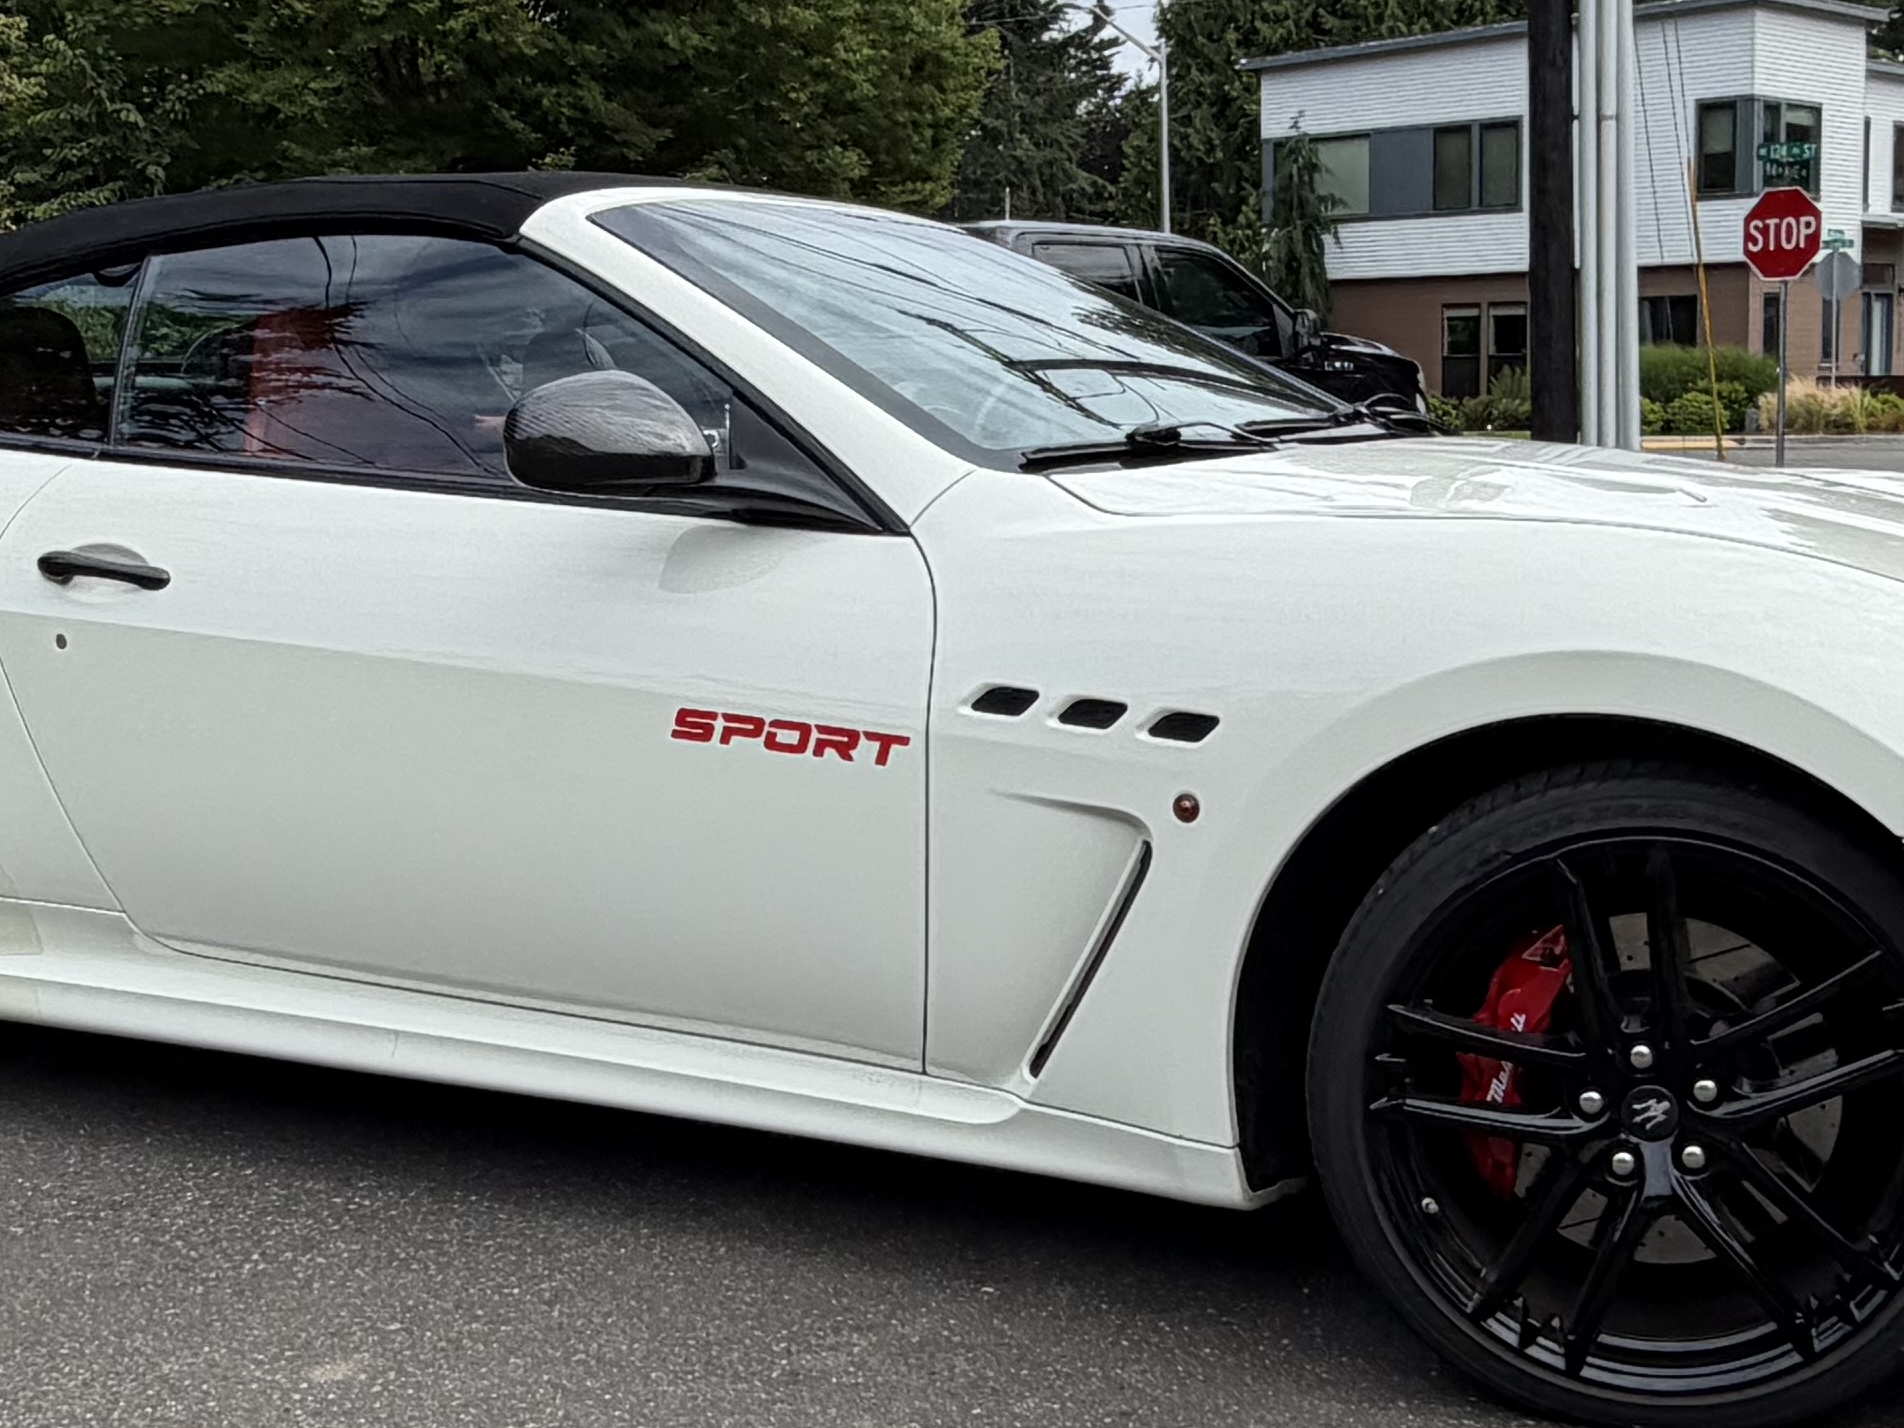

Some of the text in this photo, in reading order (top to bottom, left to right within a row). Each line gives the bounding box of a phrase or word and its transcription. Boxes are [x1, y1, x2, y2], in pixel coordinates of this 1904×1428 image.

[1803, 143, 1817, 159] ST
[1747, 216, 1816, 253] STOP
[670, 707, 911, 767] SPORT
